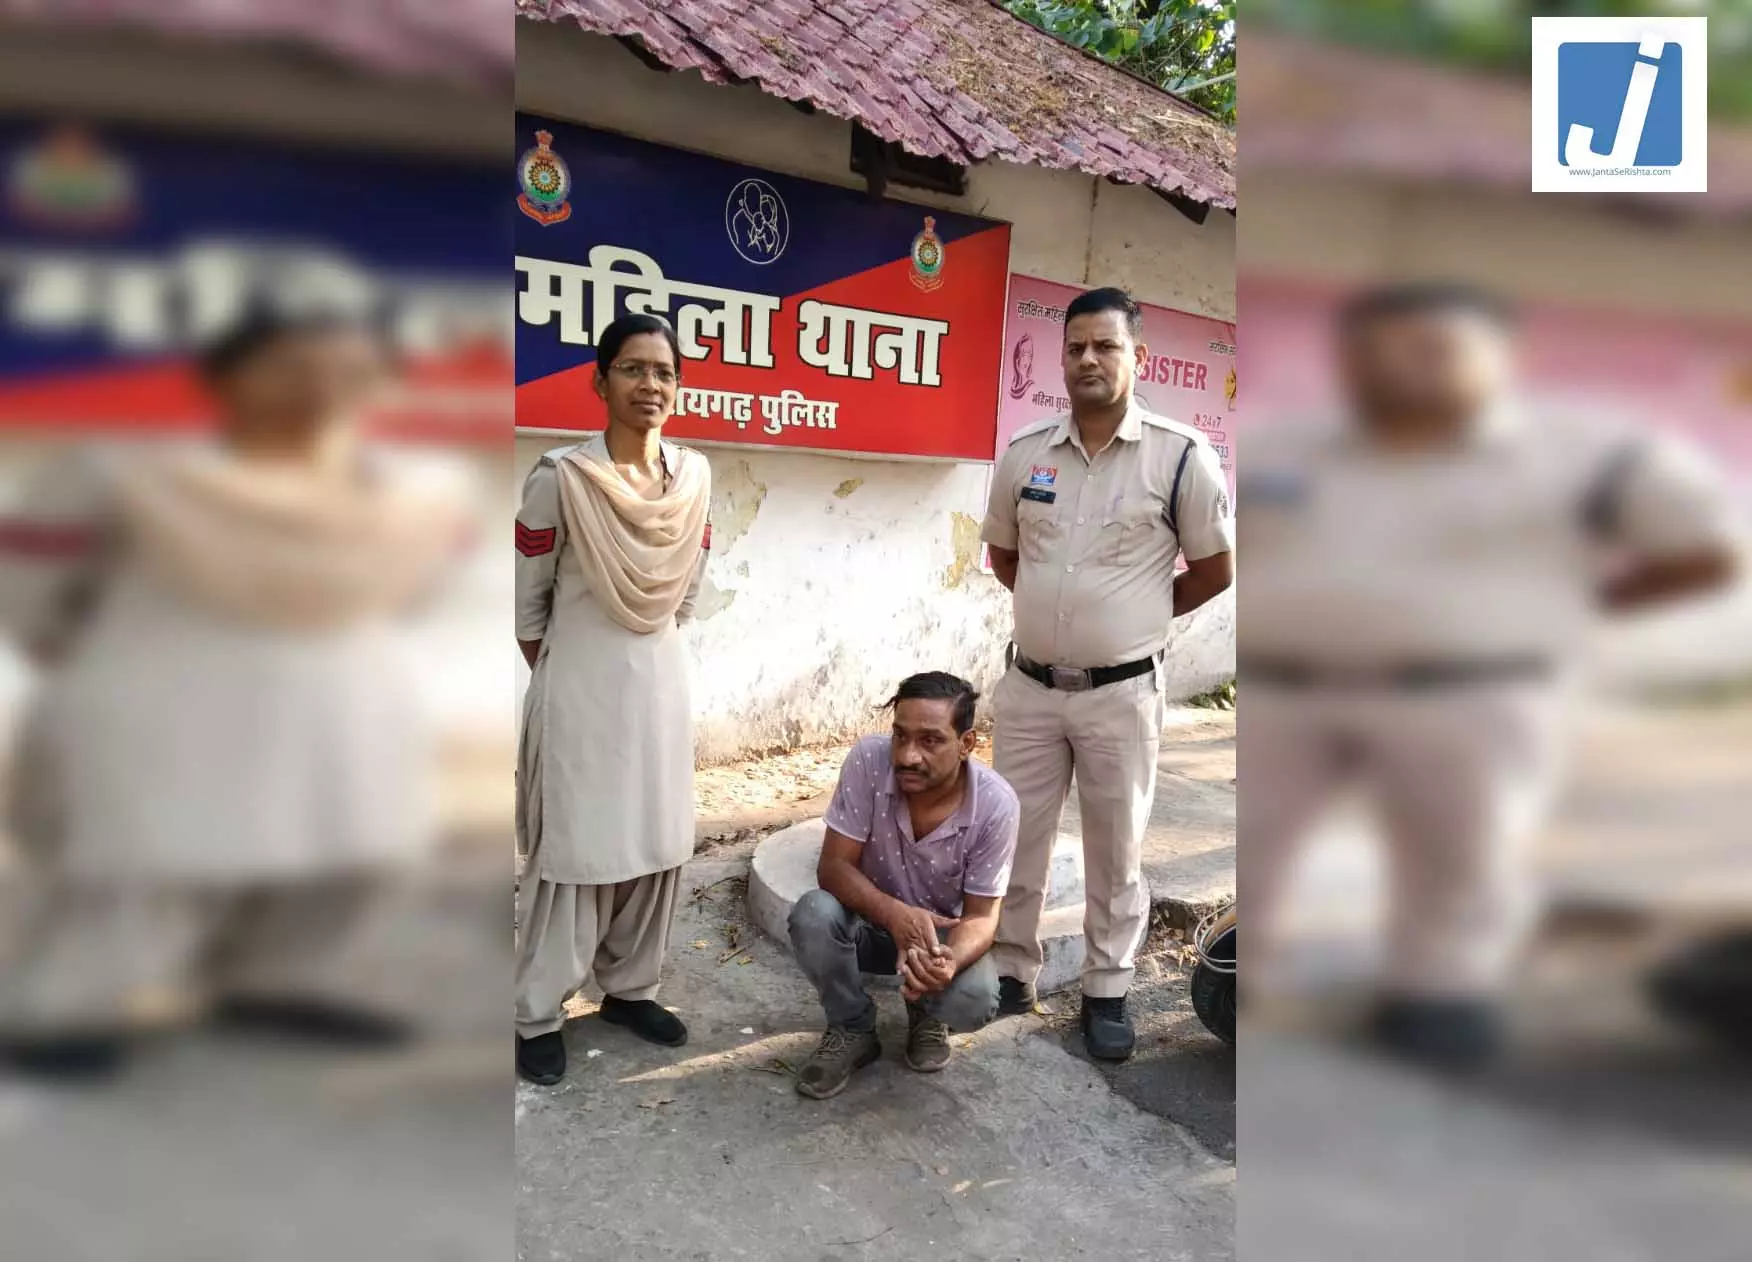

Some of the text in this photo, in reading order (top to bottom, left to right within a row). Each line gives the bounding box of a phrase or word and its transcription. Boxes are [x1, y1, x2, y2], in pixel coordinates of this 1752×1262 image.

[1045, 304, 1067, 321] महिल
[798, 299, 950, 387] थाना
[671, 387, 839, 435] ायगढ़ पुलिस
[1032, 391, 1054, 408] महिला
